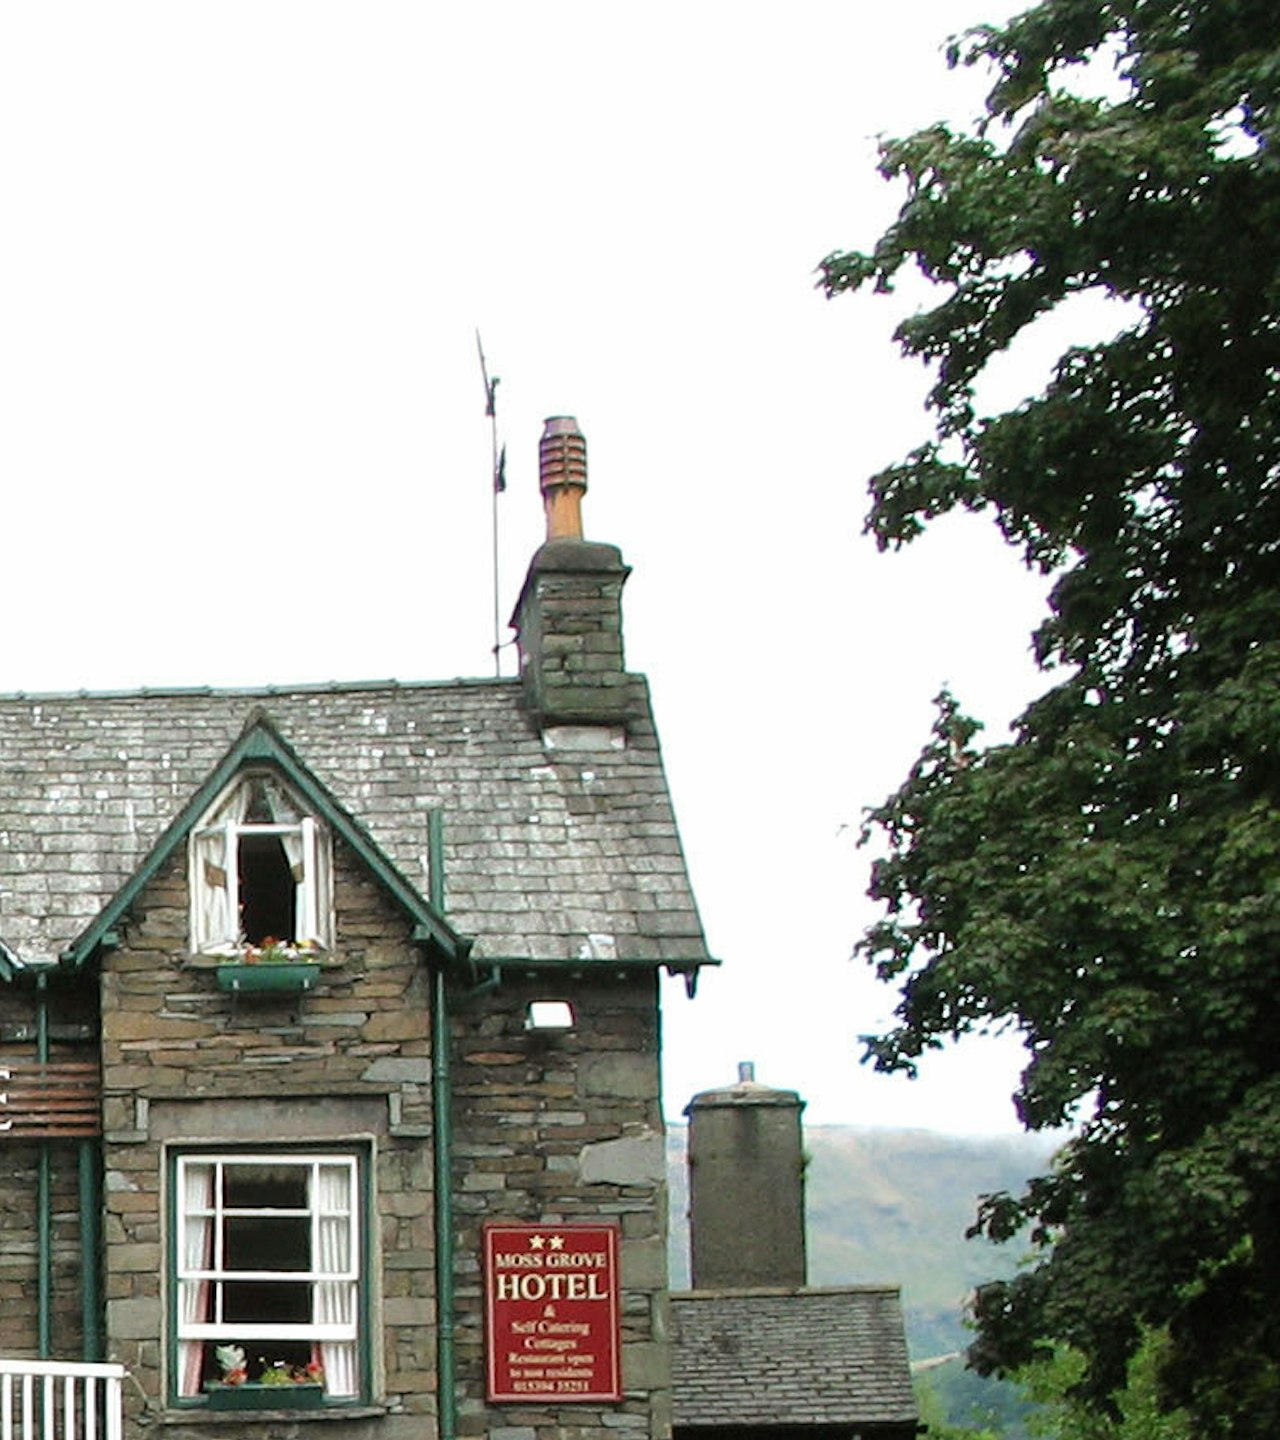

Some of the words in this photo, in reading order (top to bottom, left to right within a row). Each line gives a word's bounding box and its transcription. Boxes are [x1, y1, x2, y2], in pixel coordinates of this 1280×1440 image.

[495, 1253, 542, 1268] MOSS
[545, 1252, 606, 1268] GROVE
[497, 1274, 608, 1300] HOTEL
[538, 1320, 591, 1336] Catering
